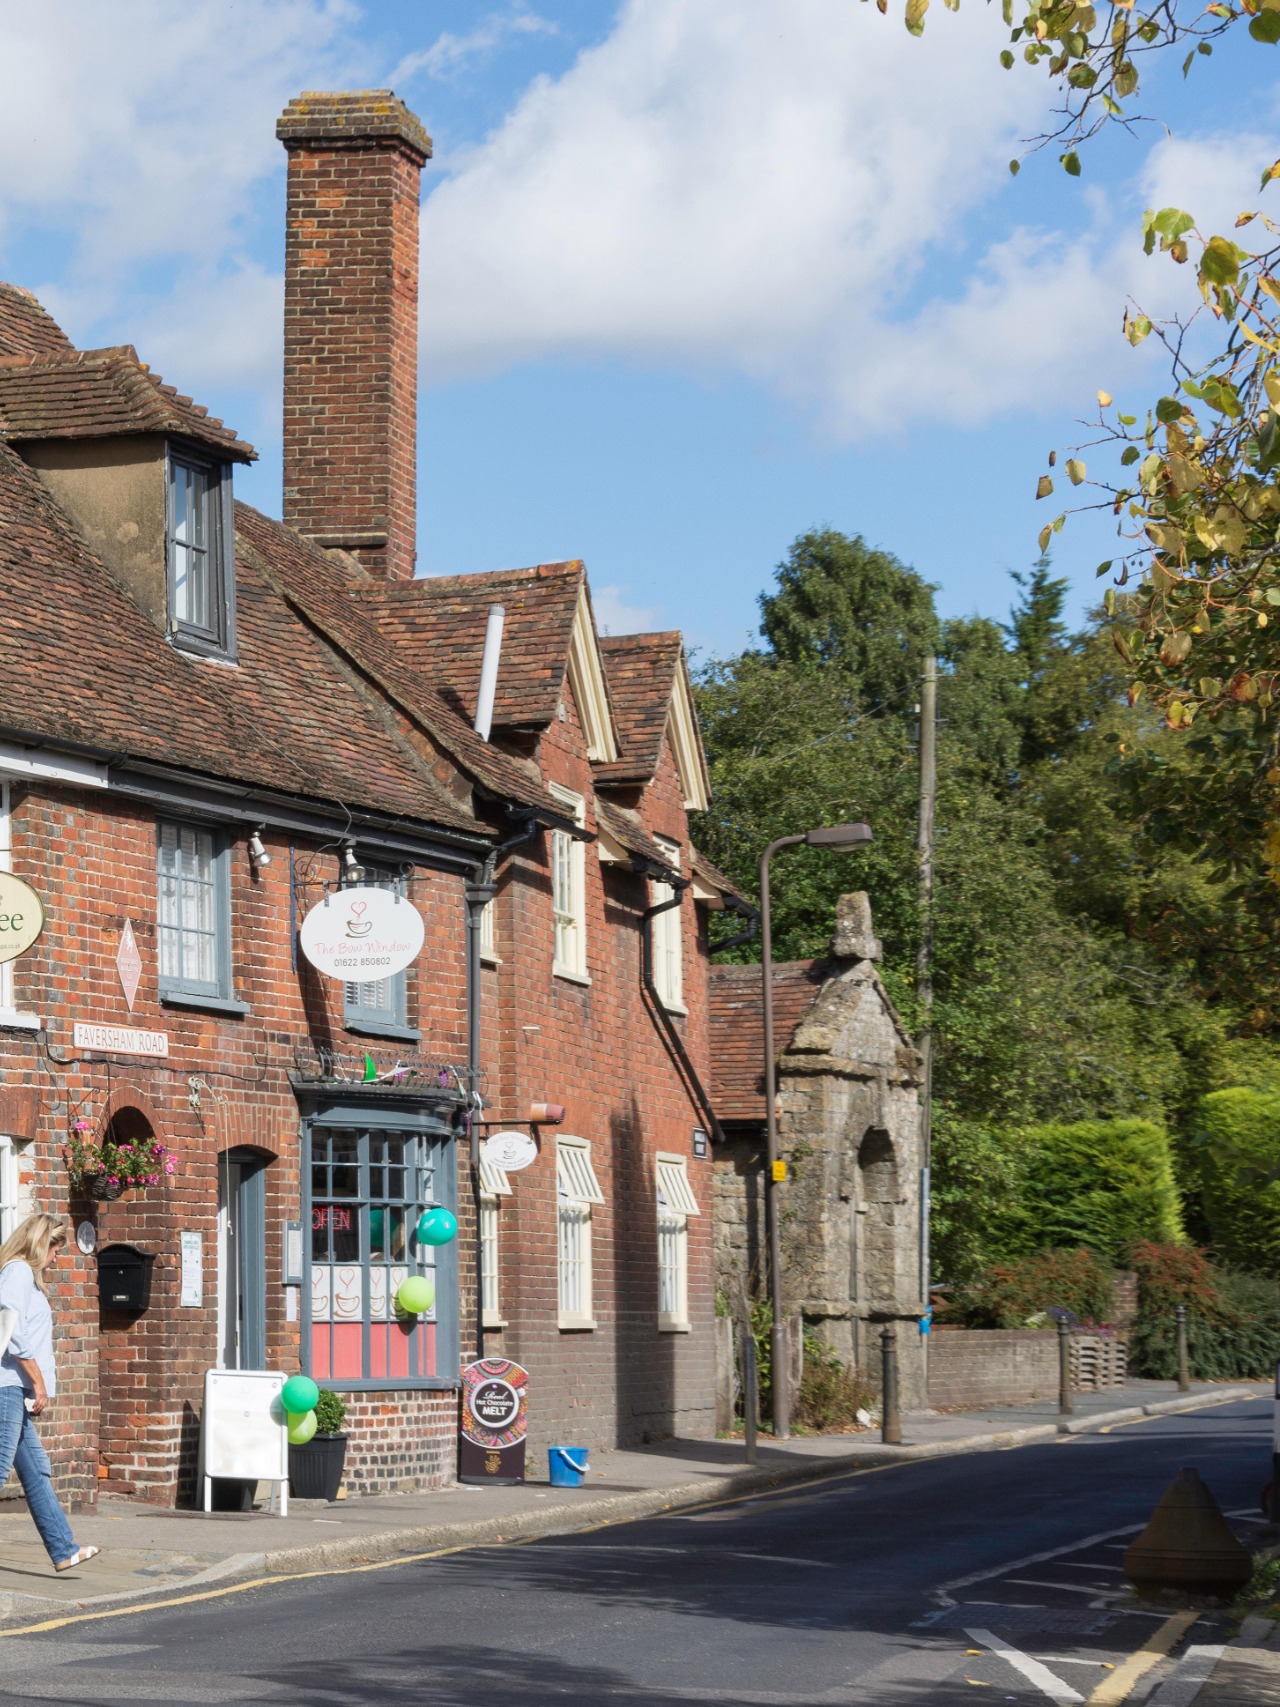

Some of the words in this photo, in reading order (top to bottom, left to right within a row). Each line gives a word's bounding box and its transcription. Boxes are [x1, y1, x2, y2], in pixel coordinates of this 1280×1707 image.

[314, 942, 335, 955] The
[338, 942, 363, 955] Bow
[365, 940, 411, 954] Window
[333, 957, 358, 967] 01622
[360, 956, 391, 966] 850802
[78, 1026, 135, 1050] FAVERSHAM
[139, 1033, 164, 1052] ROAD
[311, 1208, 351, 1231] OPEN
[487, 1399, 514, 1407] Chocolate
[482, 1406, 508, 1416] MELT
